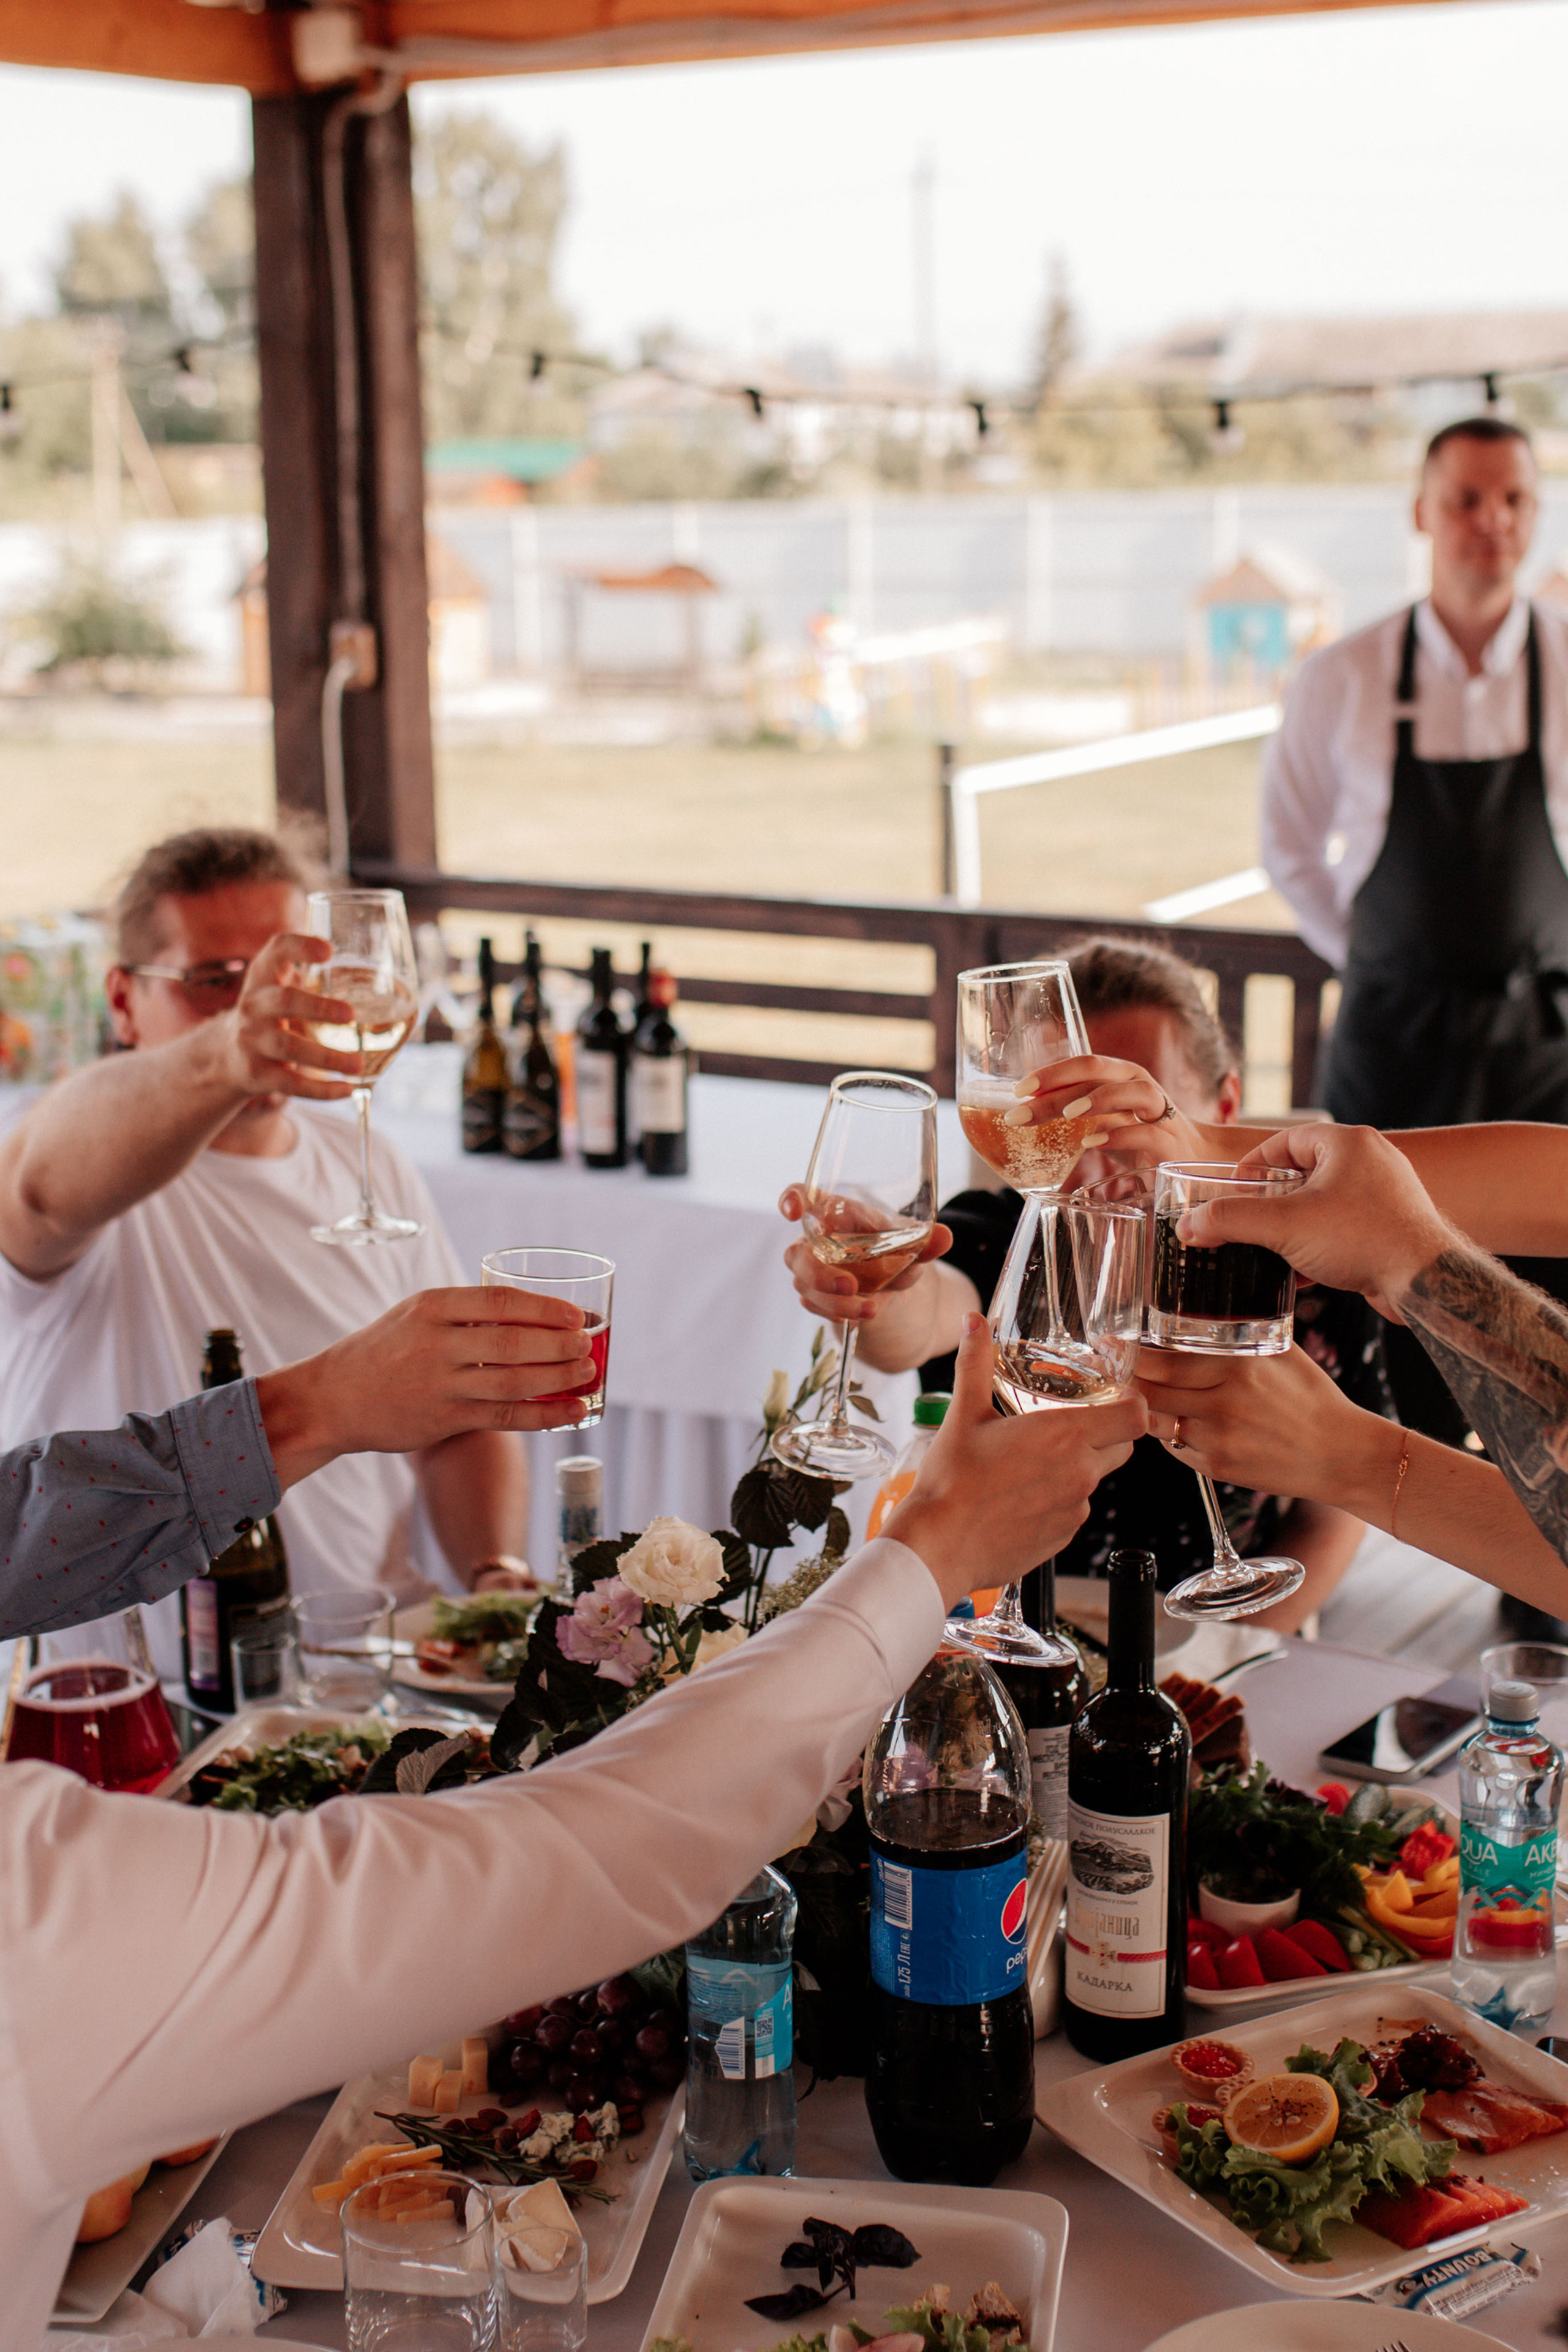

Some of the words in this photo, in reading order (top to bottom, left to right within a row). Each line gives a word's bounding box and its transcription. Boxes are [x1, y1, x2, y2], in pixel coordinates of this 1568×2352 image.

[1096, 1824, 1156, 1835] ПОЛУСЛАДКОЕ
[897, 1954, 911, 1966] Л
[897, 1966, 912, 1984] 1,75
[1077, 1971, 1134, 1992] КАДАРКА
[1422, 2250, 1493, 2288] BOUNTY
